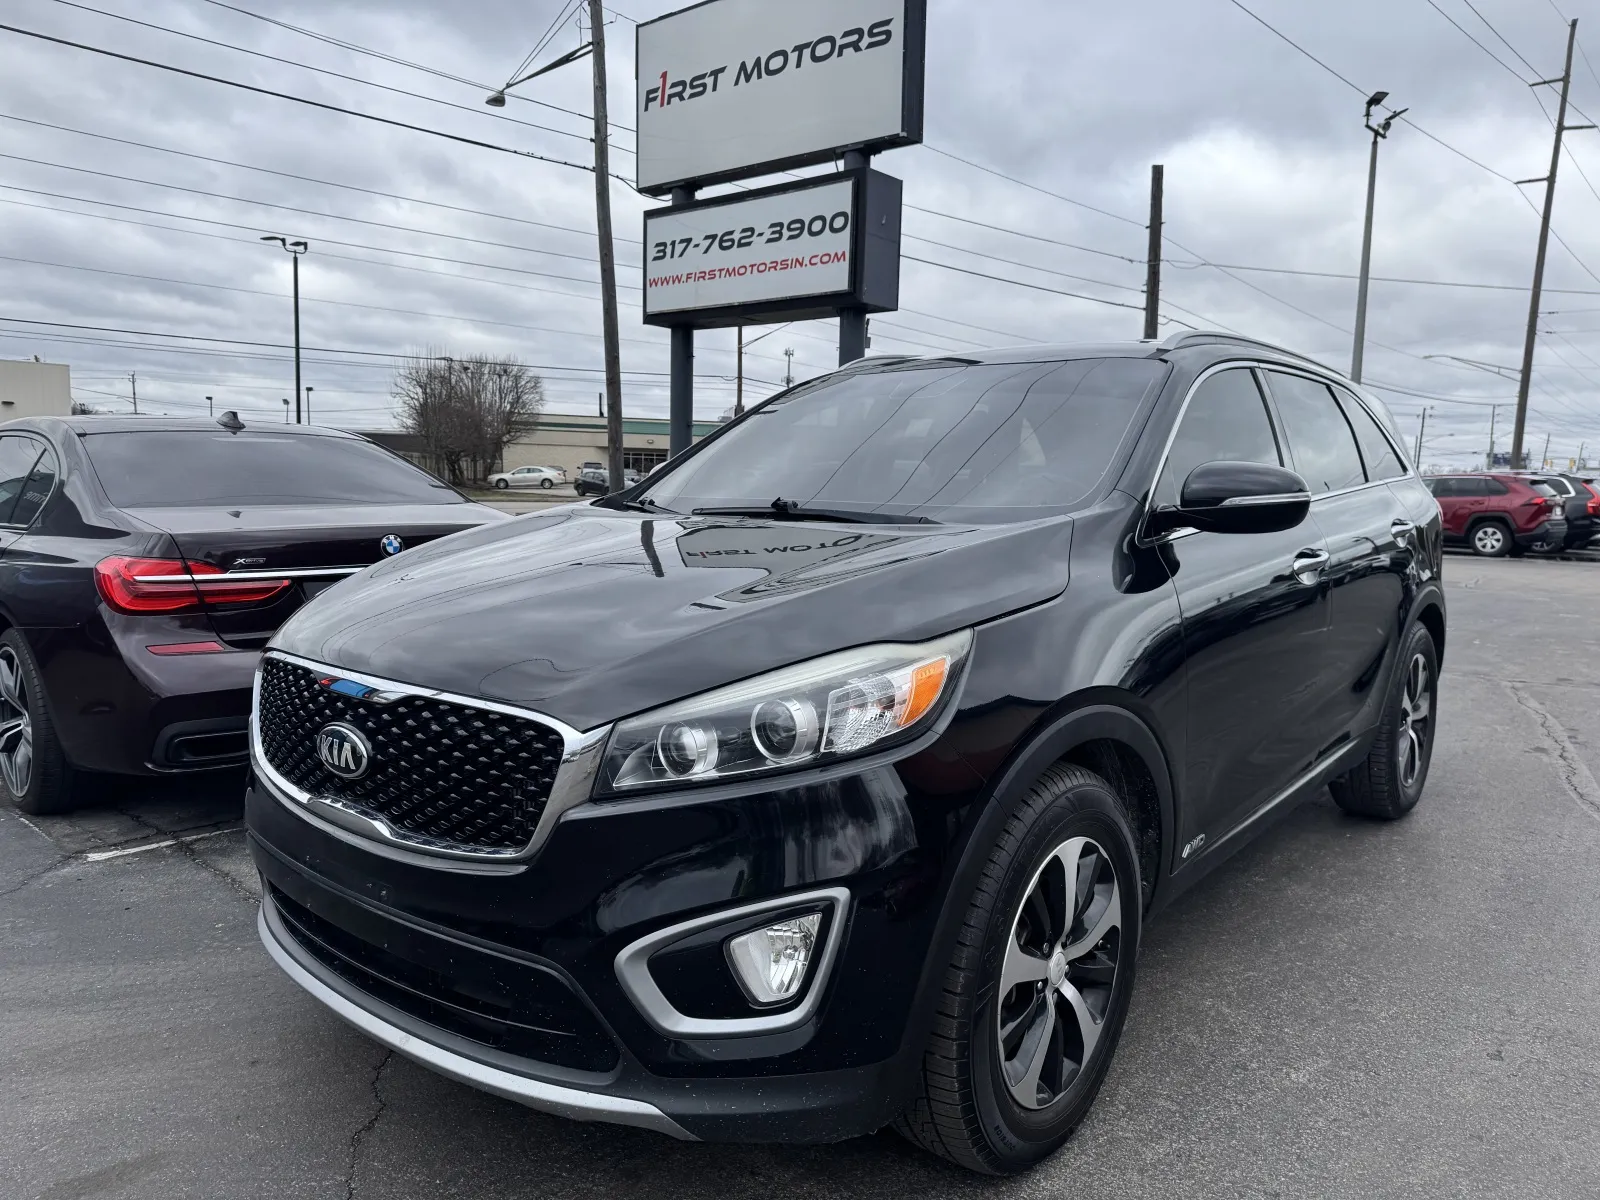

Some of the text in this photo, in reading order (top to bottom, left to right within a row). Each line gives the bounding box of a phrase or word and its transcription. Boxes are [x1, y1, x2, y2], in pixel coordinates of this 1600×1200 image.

[733, 17, 894, 87] MOTORS
[651, 211, 849, 262] 317-762-3900
[648, 250, 846, 288] WWW.FIRSTMOTORSIN.COM
[320, 734, 356, 770] KIA
